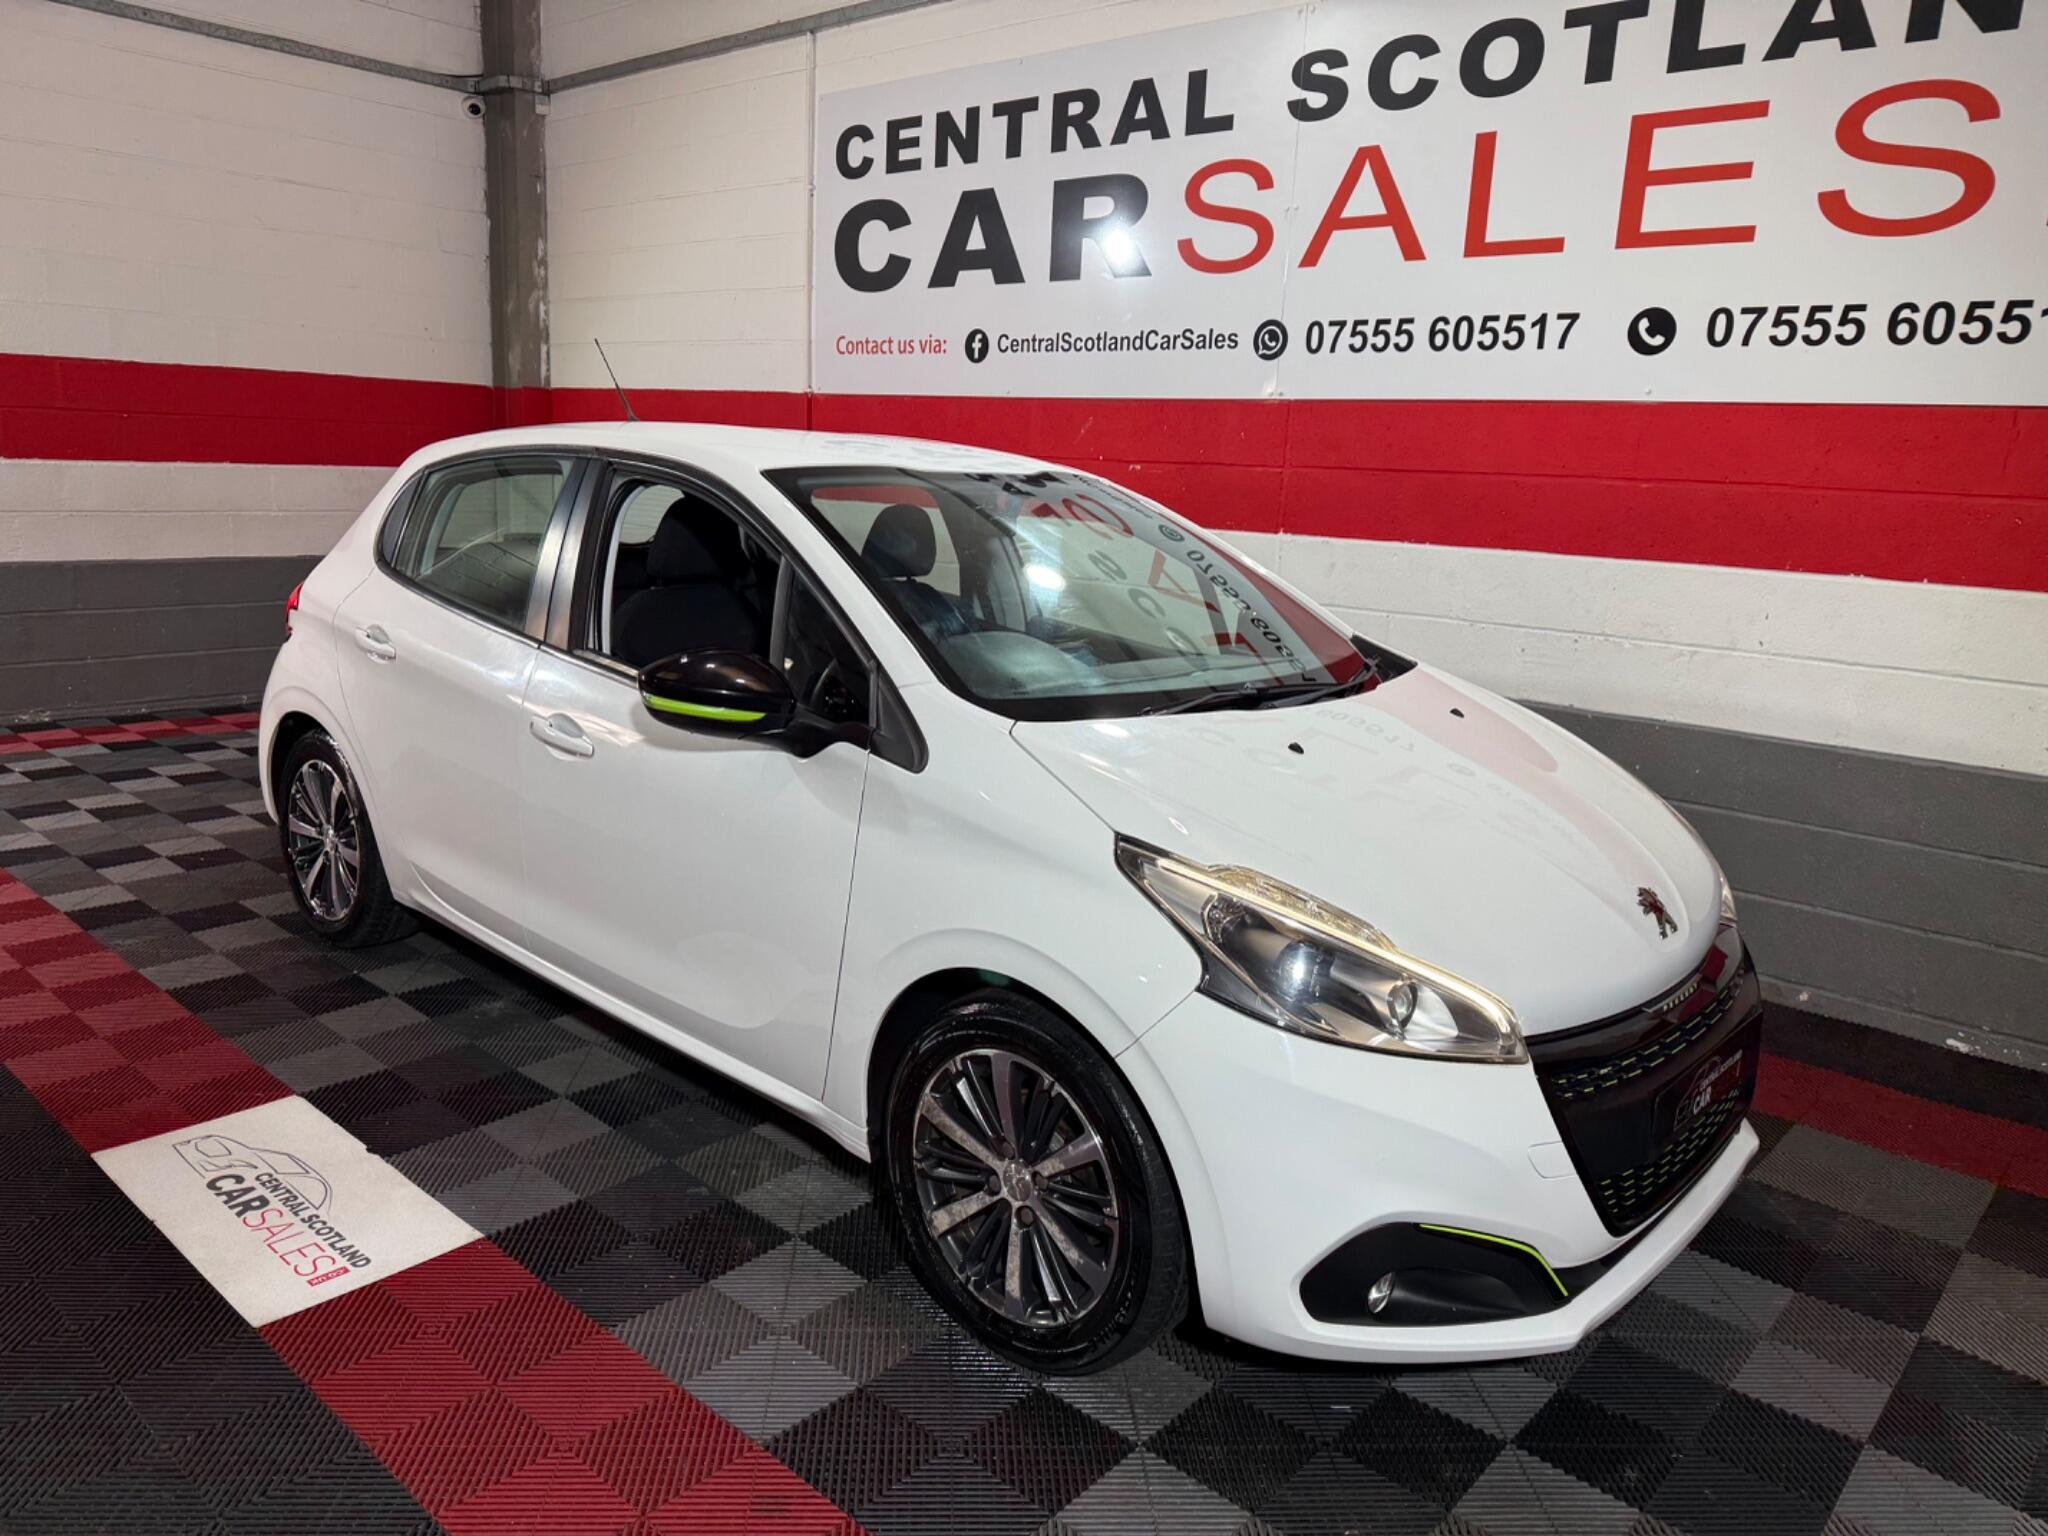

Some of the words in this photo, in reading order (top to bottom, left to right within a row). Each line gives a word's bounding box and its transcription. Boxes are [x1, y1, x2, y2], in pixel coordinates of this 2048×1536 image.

[835, 69, 1235, 180] CENTRAL
[836, 335, 893, 356] Contact
[898, 338, 915, 354] us
[920, 335, 947, 354] via:
[997, 328, 1239, 354] CentralScotlandCarSales
[1305, 317, 1415, 355] 07555
[1428, 312, 1580, 352] 605517
[1706, 303, 1868, 348] 07555
[1887, 299, 2048, 346] 6055
[254, 1172, 310, 1217] CENTRAL
[300, 1213, 372, 1268] SCOTLAND
